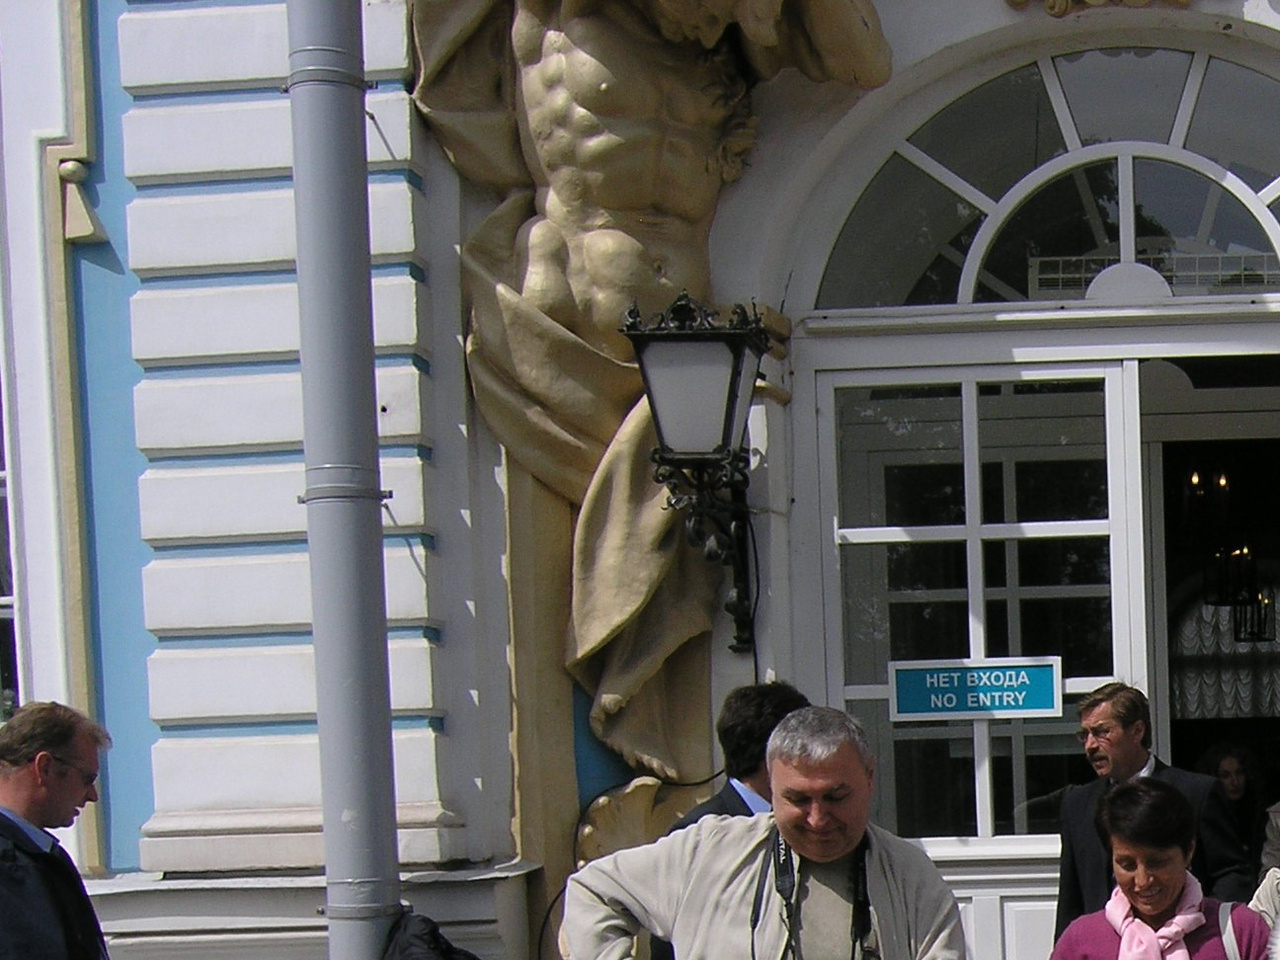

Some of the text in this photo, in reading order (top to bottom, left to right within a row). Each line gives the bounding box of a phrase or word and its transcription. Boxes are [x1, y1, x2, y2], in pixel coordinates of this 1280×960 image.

[926, 670, 1030, 688] НЕТ ВХОДА
[931, 691, 1027, 708] NO ENTRY
